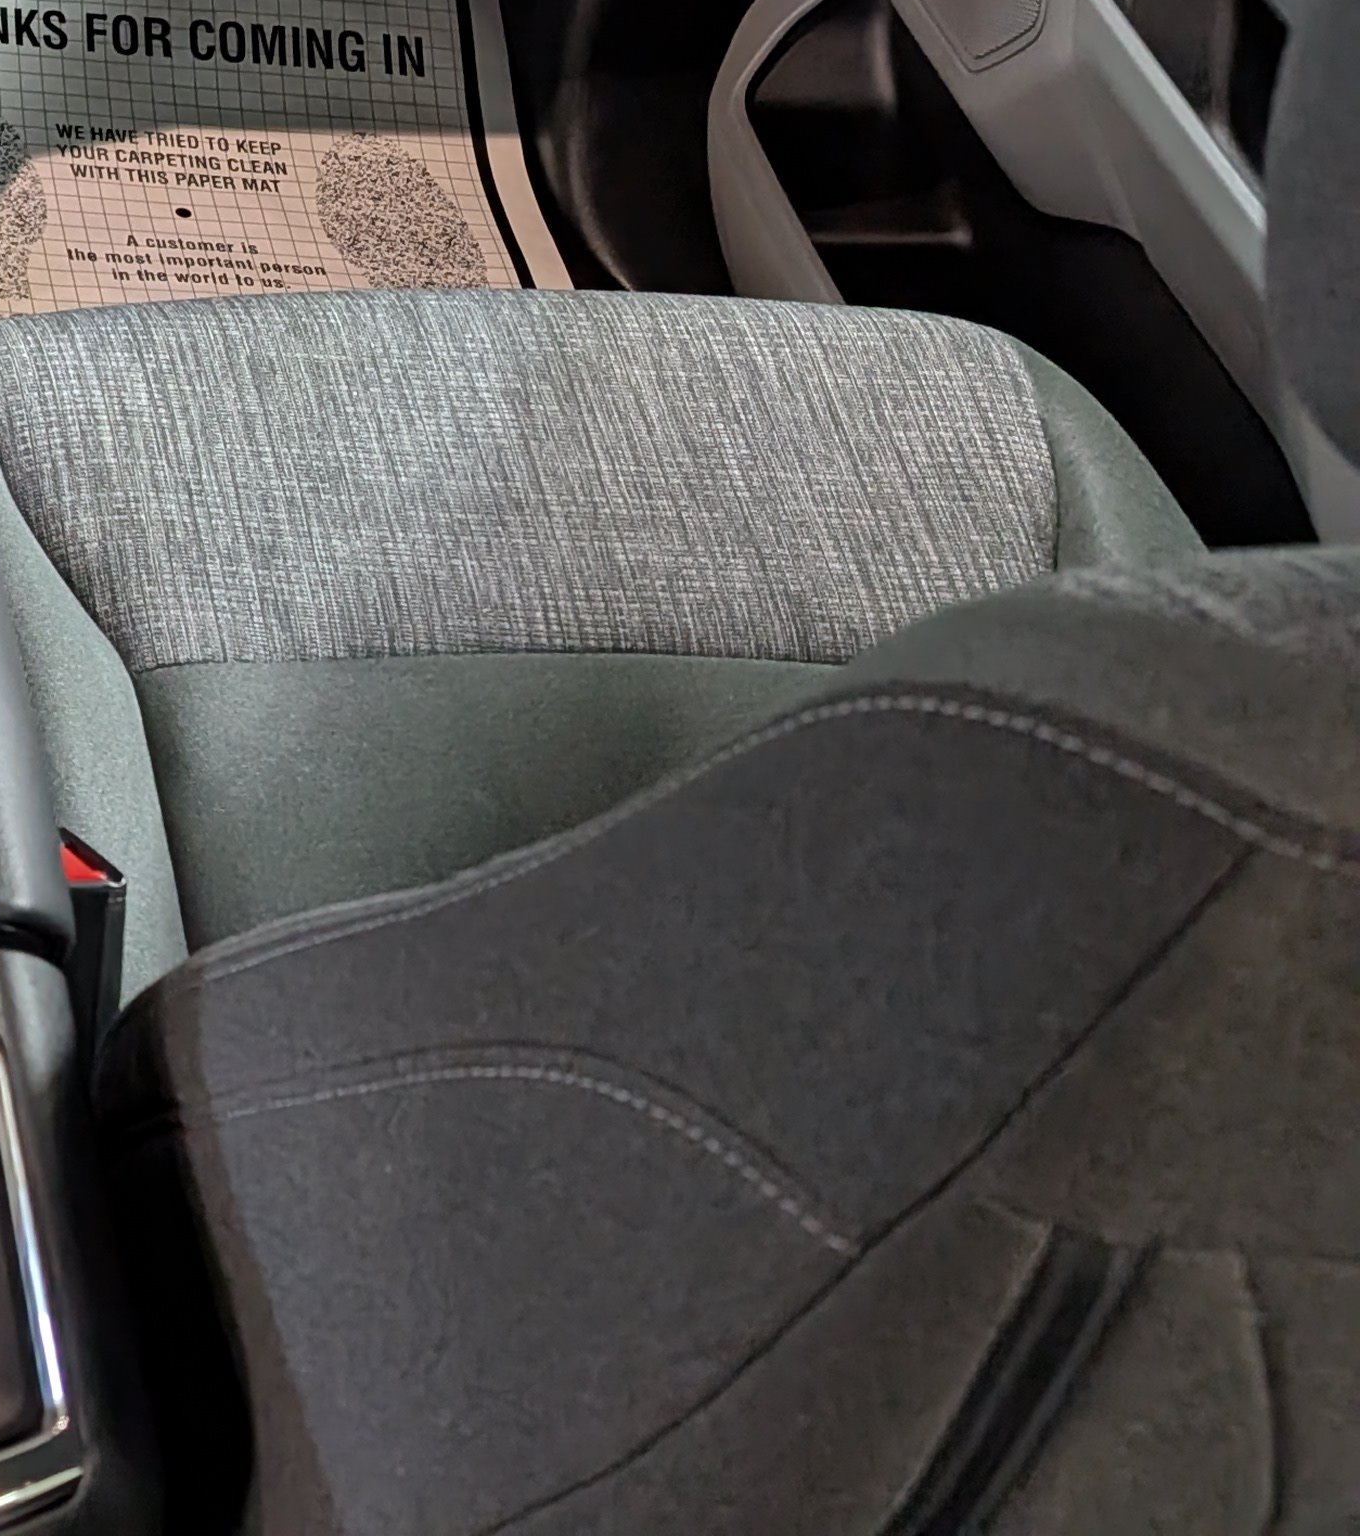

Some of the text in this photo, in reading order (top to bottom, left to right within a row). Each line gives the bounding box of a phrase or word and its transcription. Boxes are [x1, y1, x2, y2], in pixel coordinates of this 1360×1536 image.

[86, 12, 172, 58] FOR
[189, 18, 366, 73] COMING
[383, 33, 425, 78] IN
[55, 123, 282, 156] WE HAVE TRIED TO KEEP
[56, 144, 288, 175] YOUR CARPETING CLEAN
[70, 163, 281, 193] WITH THIS PAPER MAT
[126, 235, 259, 255] A customer is
[66, 248, 327, 277] the most important person
[112, 268, 292, 289] in the world to us.
